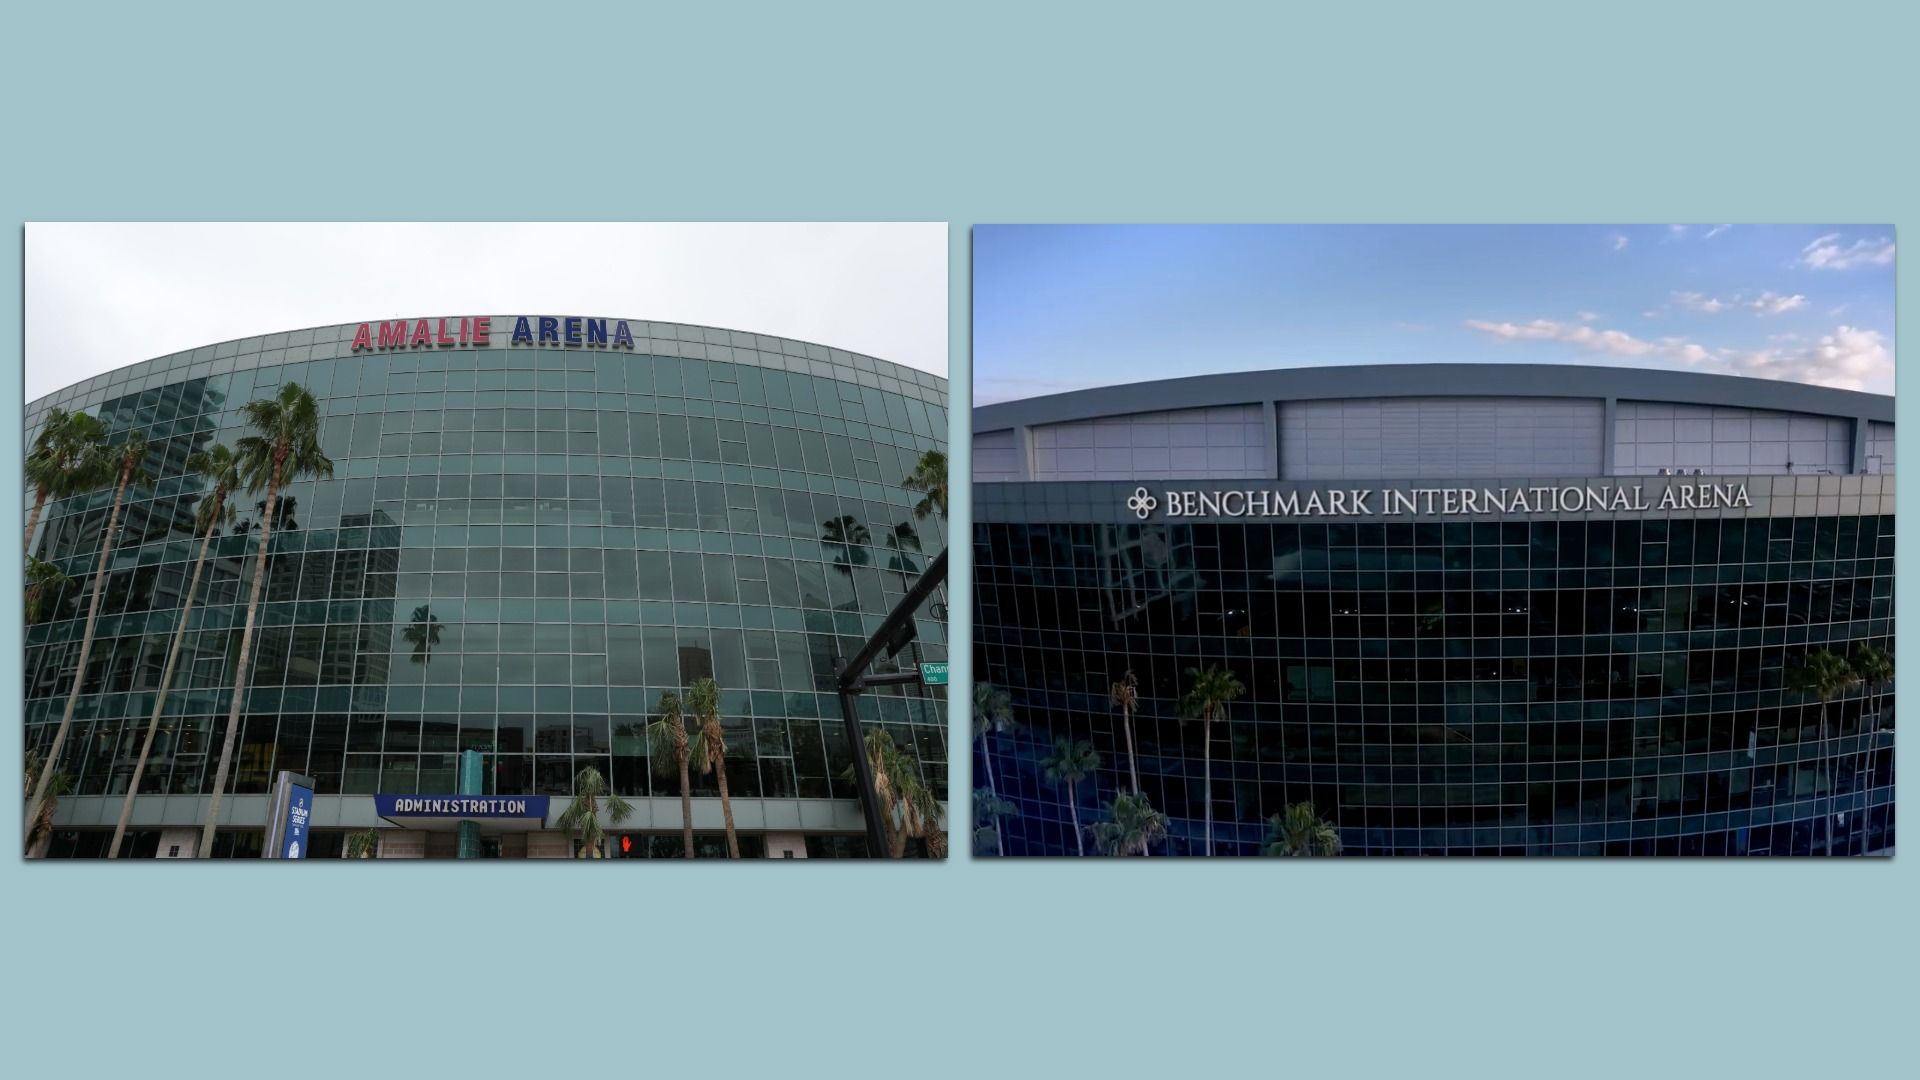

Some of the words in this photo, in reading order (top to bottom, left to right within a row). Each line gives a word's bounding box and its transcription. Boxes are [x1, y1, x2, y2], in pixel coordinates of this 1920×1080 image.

[351, 316, 491, 350] AMALIE
[511, 315, 635, 349] ARENA
[1166, 489, 1374, 517] BENCHMARK
[1382, 486, 1650, 515] INTERNATIONAL
[1657, 483, 1752, 511] ARENA
[395, 798, 526, 814] ADMINISTRATION
